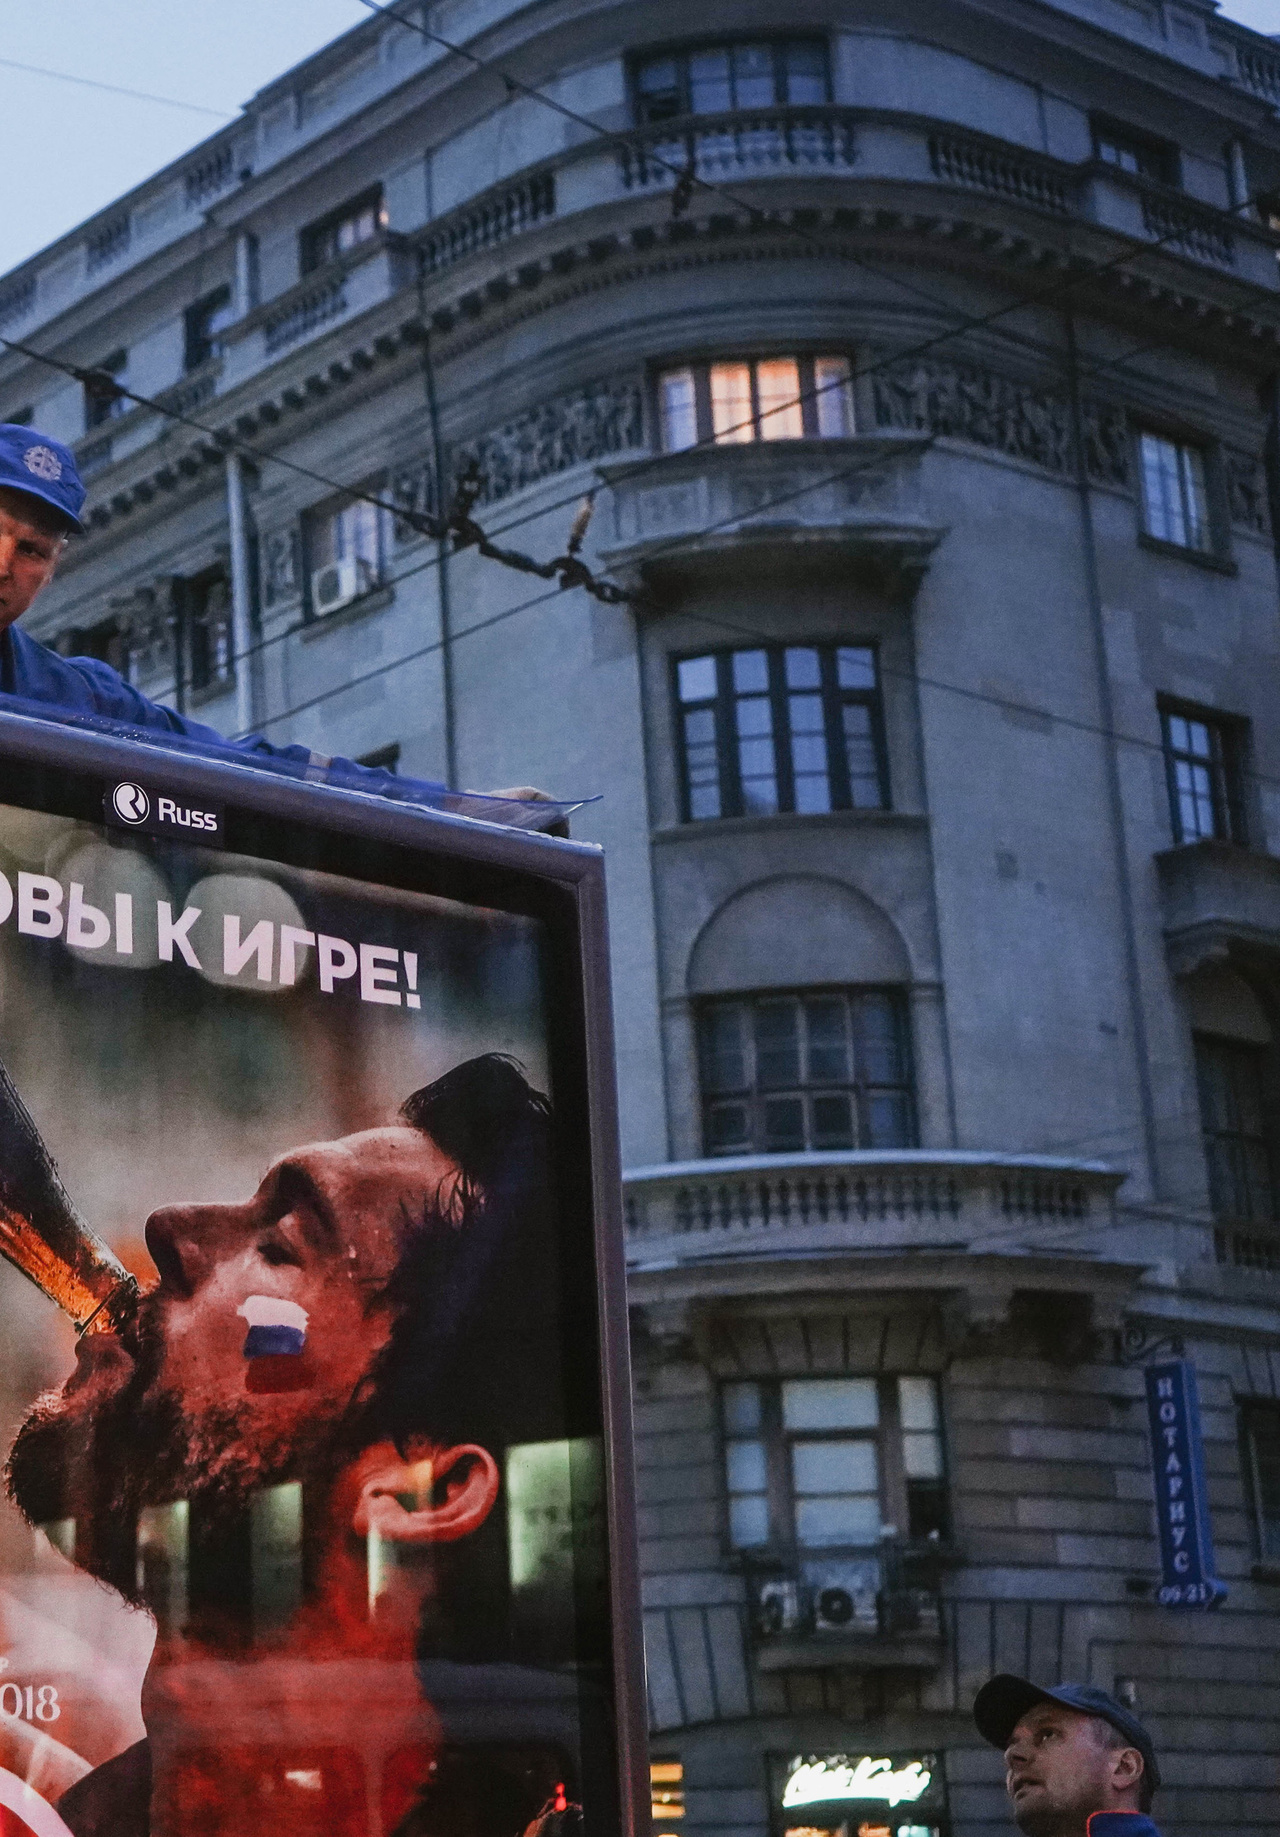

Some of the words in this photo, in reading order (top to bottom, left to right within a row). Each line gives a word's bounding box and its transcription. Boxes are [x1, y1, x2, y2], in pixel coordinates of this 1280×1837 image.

[158, 797, 218, 831] Russ
[157, 901, 203, 969] К
[223, 914, 422, 1009] ИГРЕ!
[1157, 1377, 1190, 1574] НОТАРИУС
